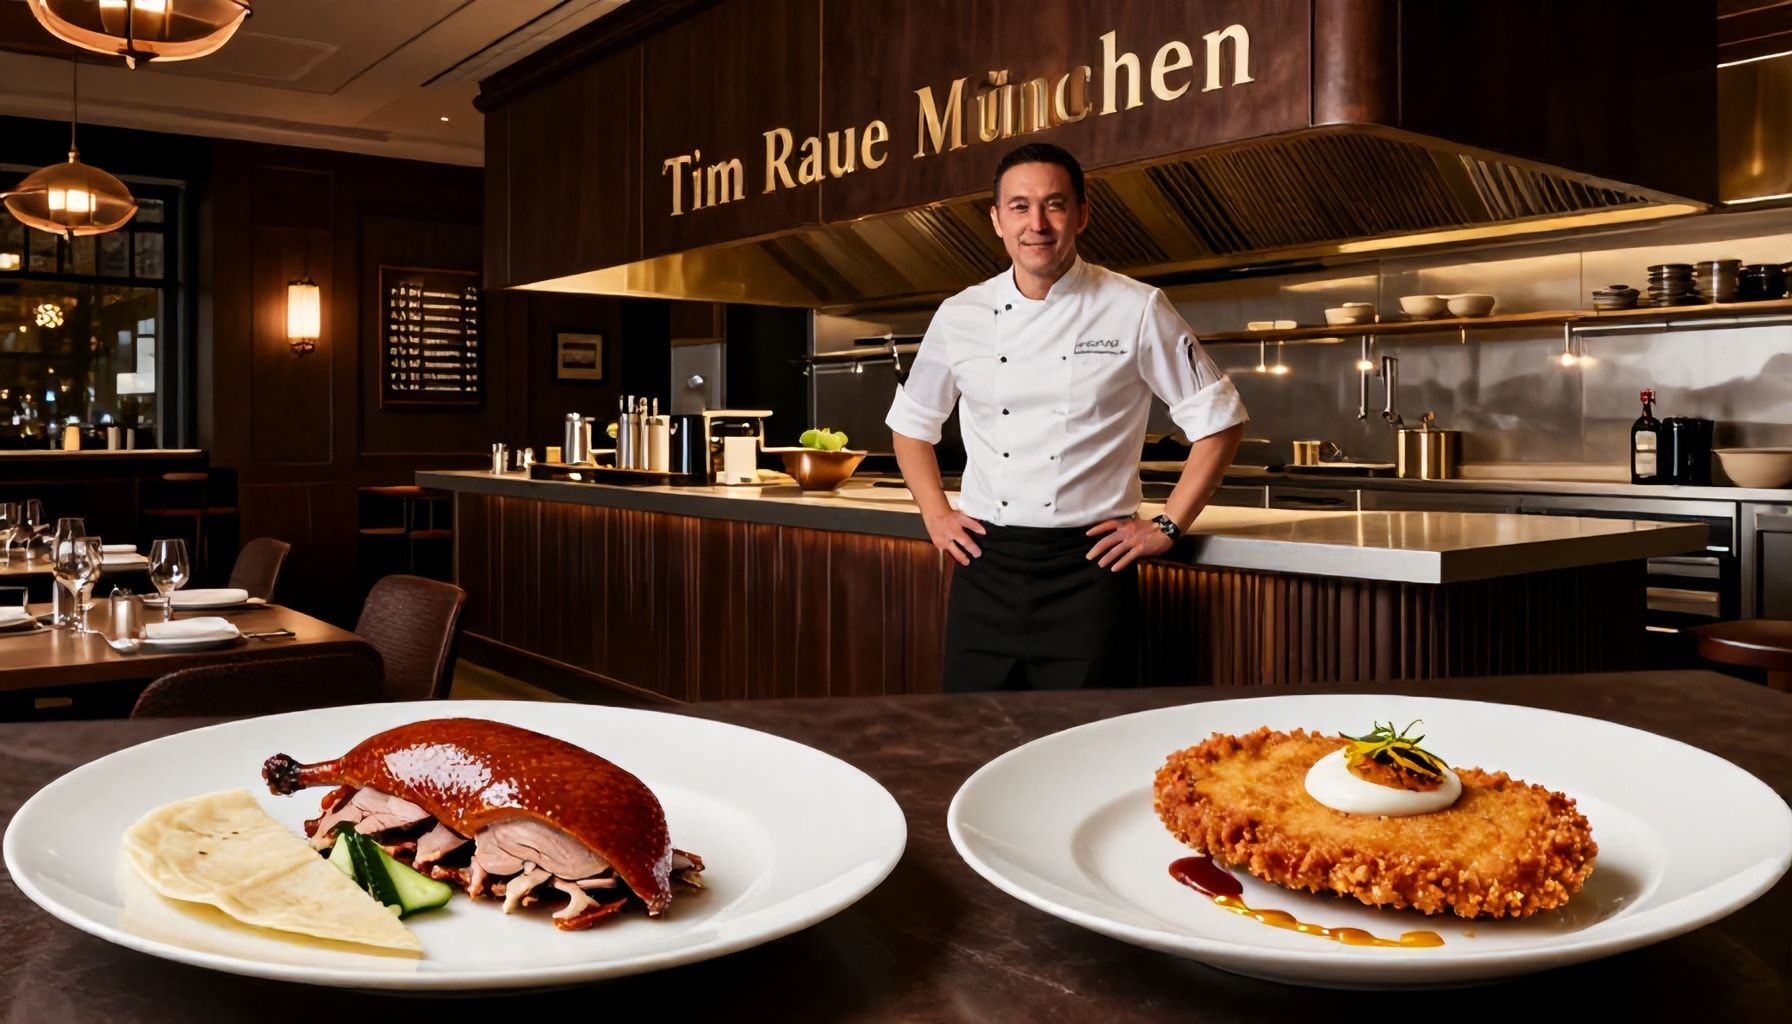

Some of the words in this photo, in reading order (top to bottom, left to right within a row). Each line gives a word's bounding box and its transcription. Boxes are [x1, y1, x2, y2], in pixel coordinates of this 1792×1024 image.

[662, 149, 746, 217] Tim
[762, 120, 890, 195] Raue
[913, 23, 1255, 160] München
